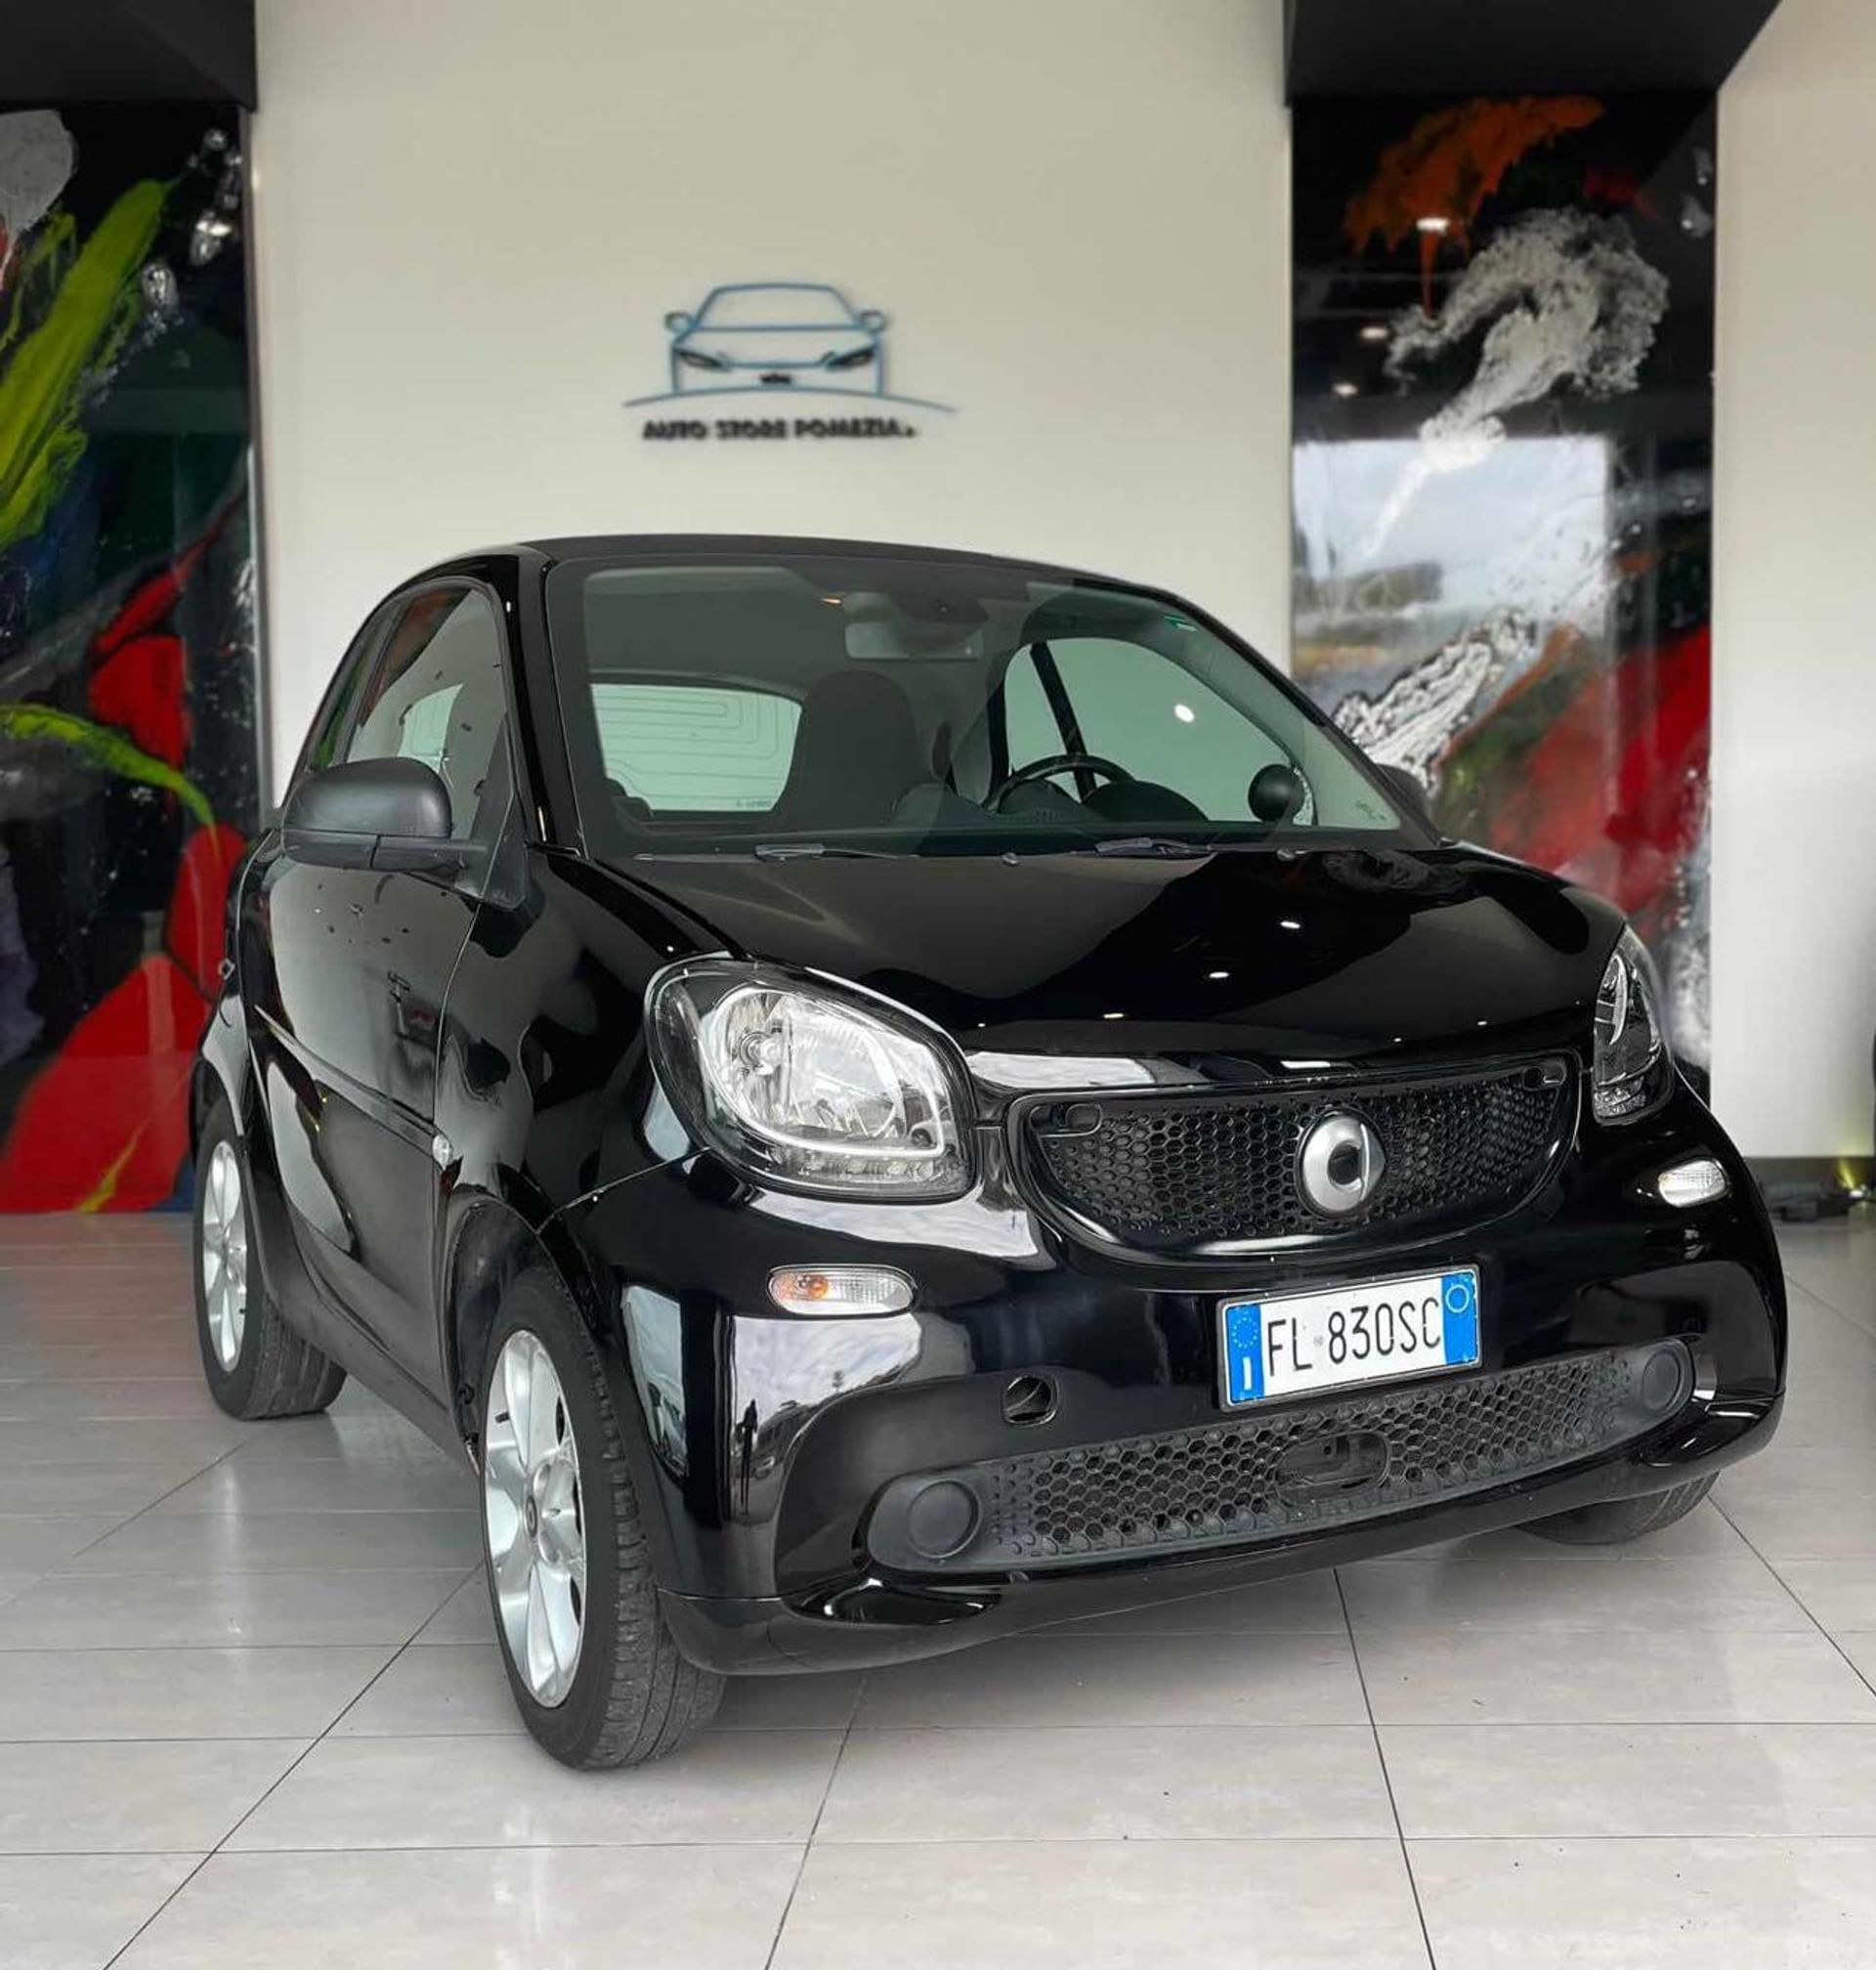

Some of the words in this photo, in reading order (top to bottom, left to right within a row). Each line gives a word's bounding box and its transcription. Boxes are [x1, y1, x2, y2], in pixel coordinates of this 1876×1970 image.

[643, 419, 707, 440] AUTO
[715, 419, 787, 440] STORE
[1267, 1317, 1313, 1377] FL
[1328, 1297, 1441, 1365] 830SC
